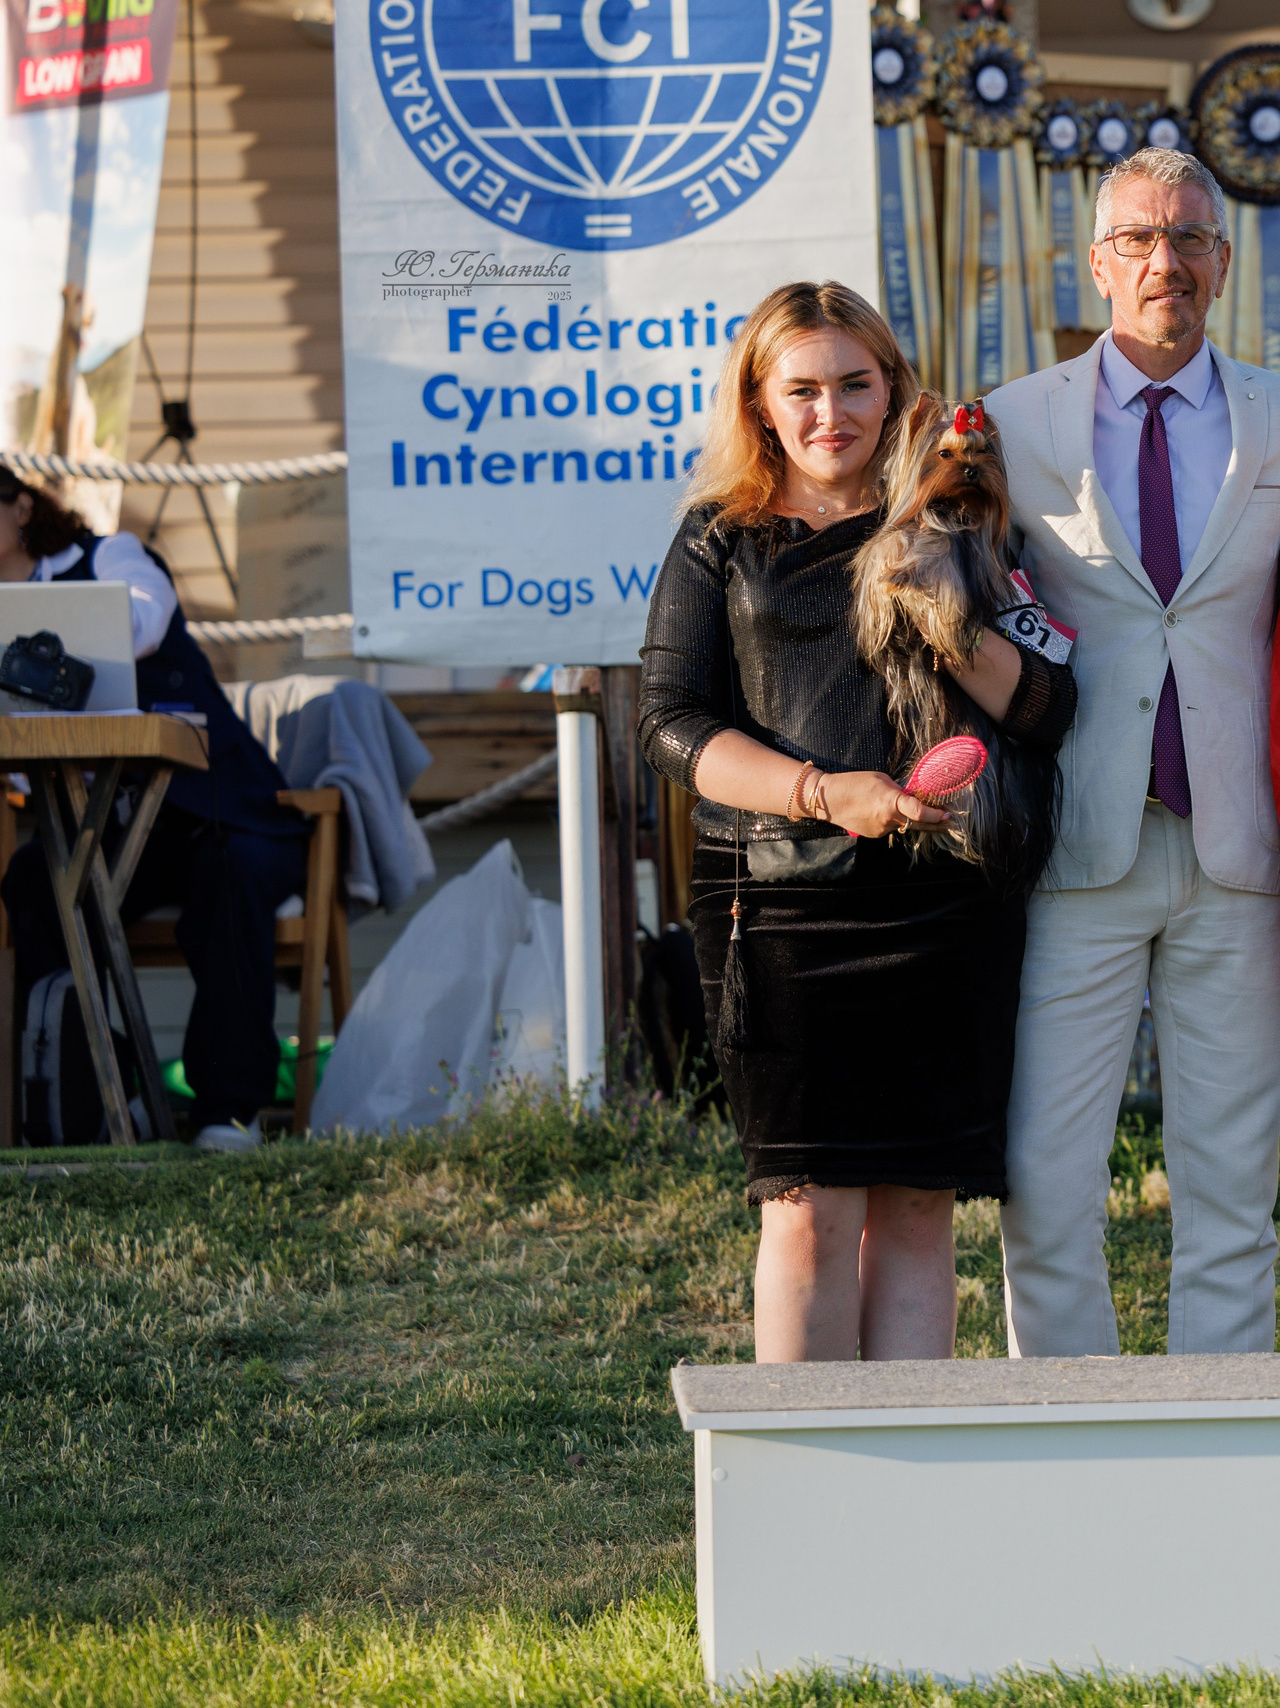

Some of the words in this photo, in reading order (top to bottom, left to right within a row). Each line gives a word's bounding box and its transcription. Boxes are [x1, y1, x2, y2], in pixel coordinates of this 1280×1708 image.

[24, 54, 78, 97] LOW
[422, 367, 718, 432] Cynologi
[393, 571, 464, 609] For
[481, 568, 595, 615] Dogs
[1015, 609, 1051, 649] 61
